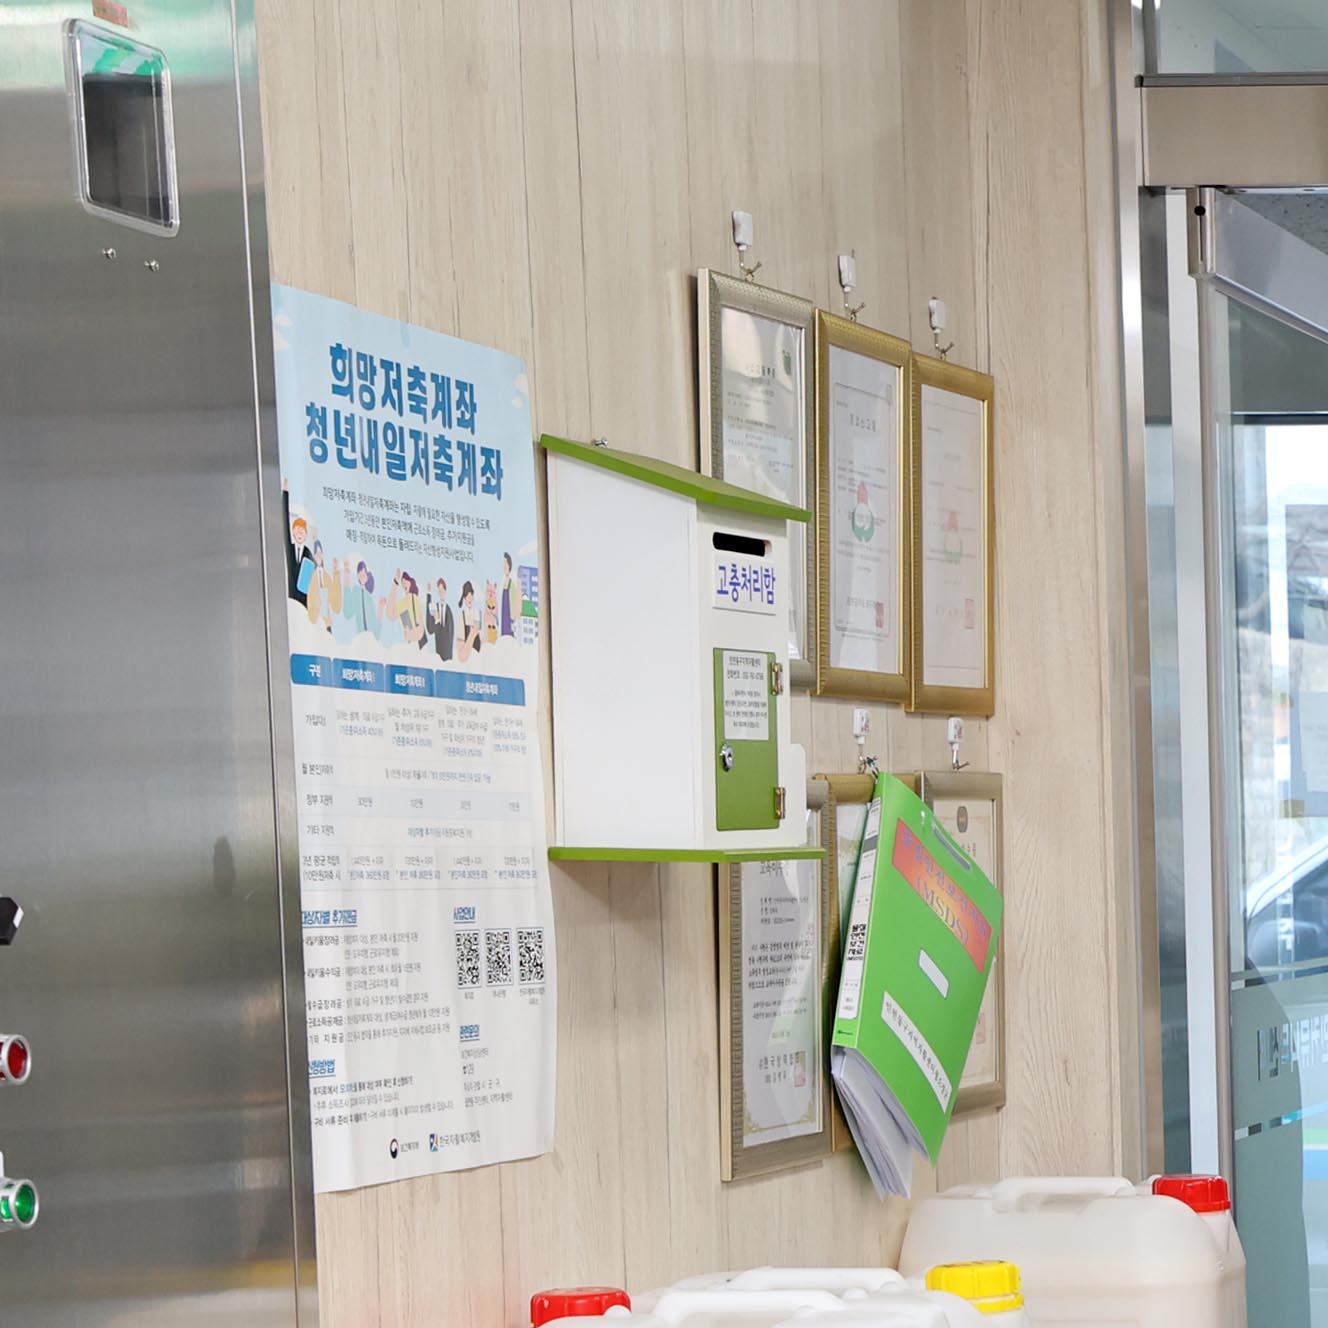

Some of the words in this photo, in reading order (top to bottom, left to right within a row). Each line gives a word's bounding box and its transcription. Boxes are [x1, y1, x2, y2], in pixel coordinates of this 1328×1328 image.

[329, 342, 477, 435] 희망저축계좌
[305, 402, 503, 501] 청년내일저축계좌
[717, 562, 776, 605] 고충처리함
[916, 876, 969, 944] (MSDS)
